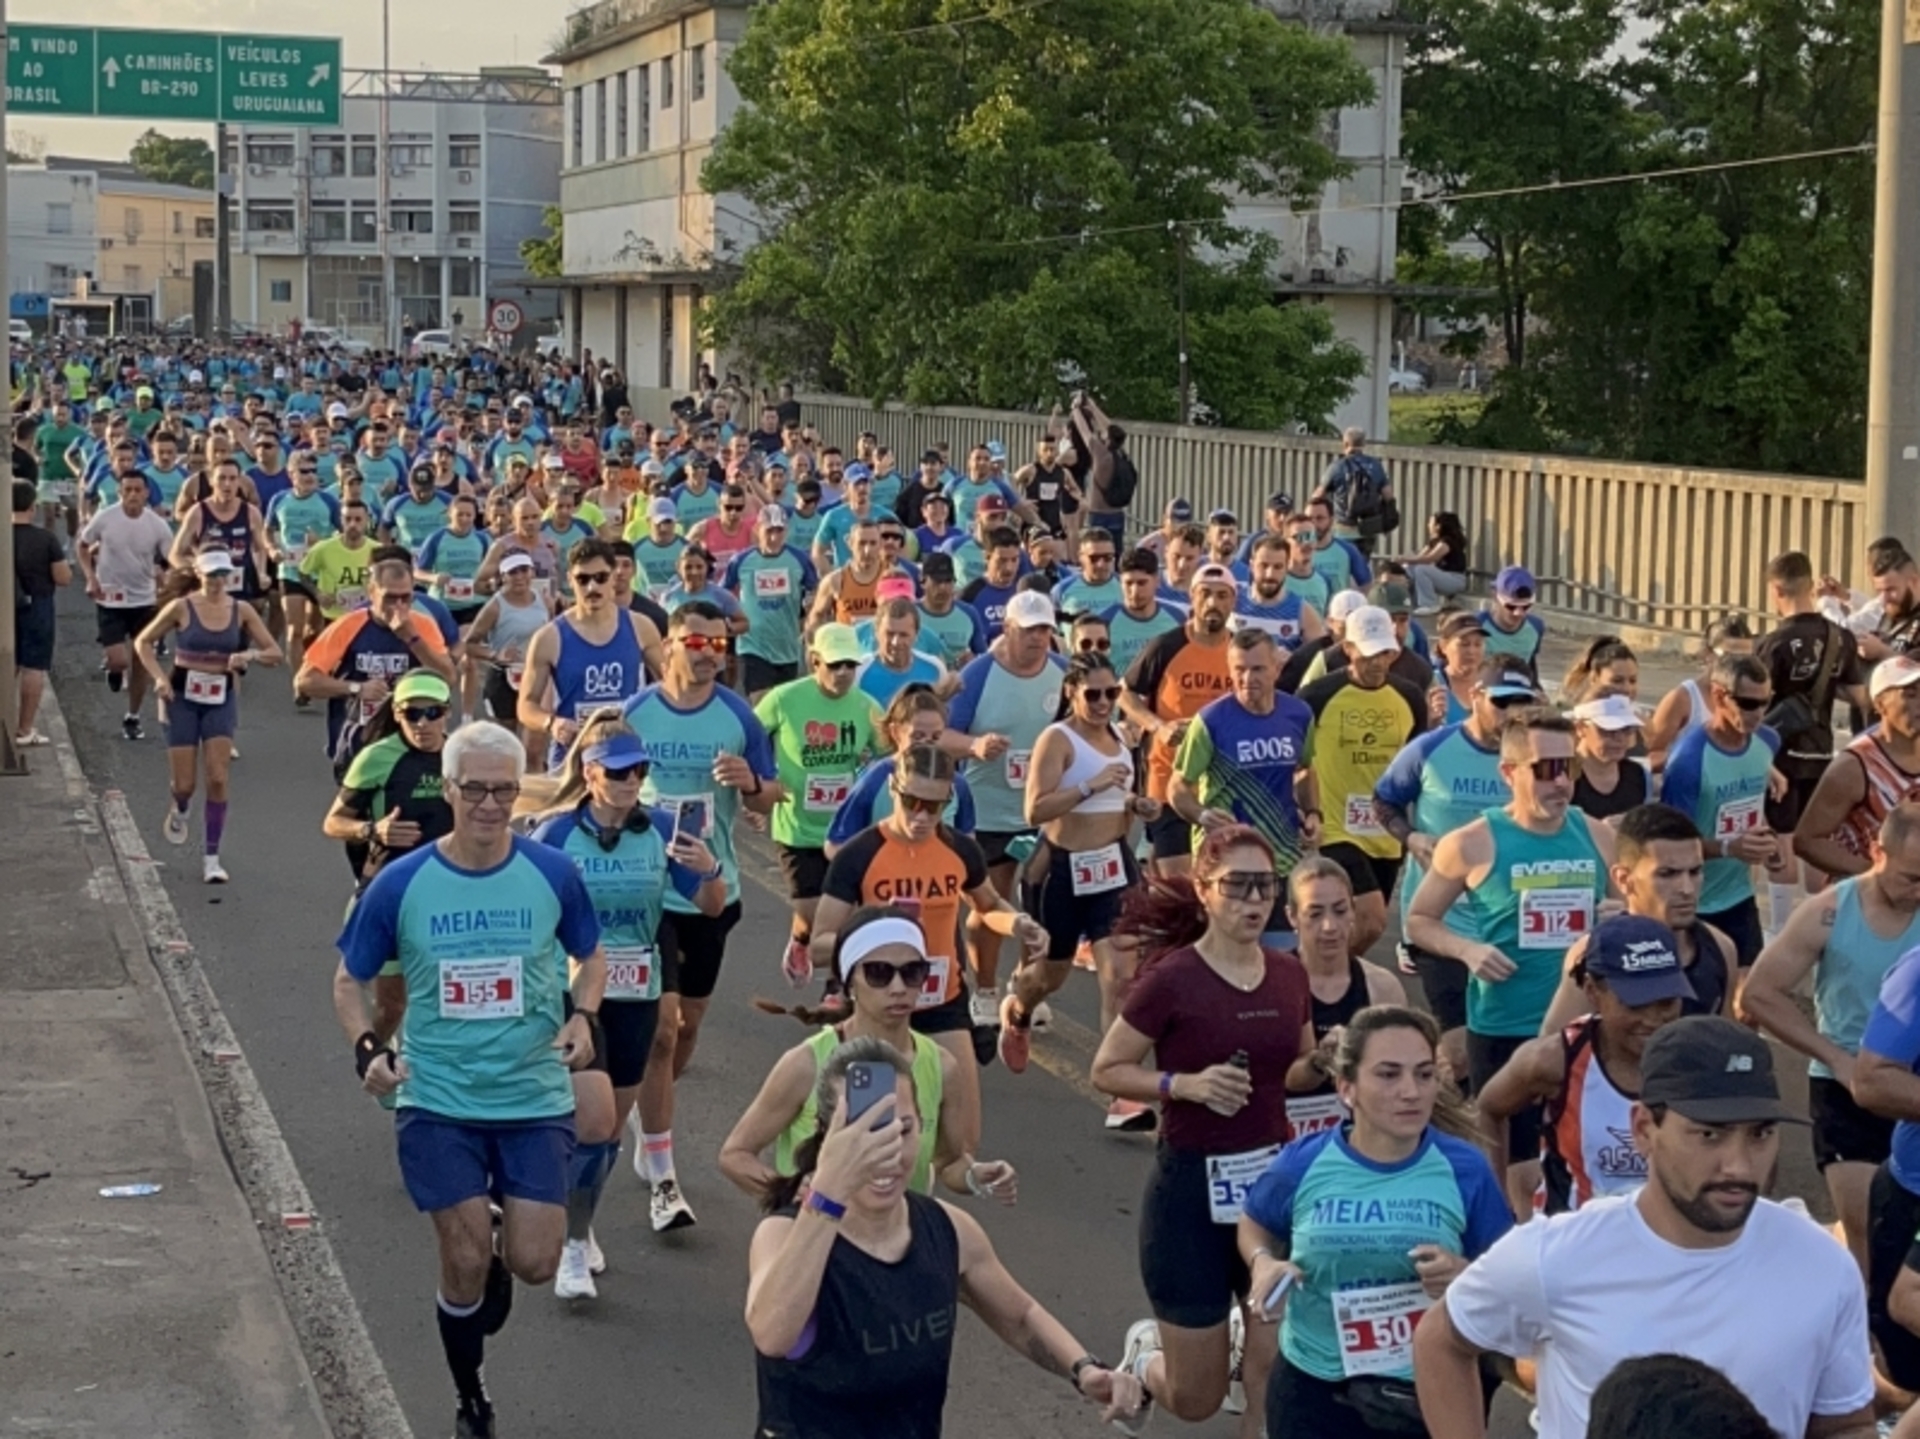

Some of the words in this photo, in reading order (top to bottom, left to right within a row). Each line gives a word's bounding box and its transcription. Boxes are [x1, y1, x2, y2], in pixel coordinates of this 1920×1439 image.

[31, 37, 78, 54] VINDO
[228, 41, 301, 64] VEÍCULOS
[23, 61, 44, 78] AO
[124, 52, 214, 73] CAMINHÕES
[141, 79, 198, 96] BR-290
[239, 71, 288, 88] LEVES
[5, 86, 61, 104] BRASIL
[233, 95, 325, 114] URUGUAIANA
[497, 309, 517, 323] 30
[646, 742, 690, 760] MEIA
[1453, 777, 1499, 796] MEIA
[1511, 860, 1596, 878] EVIDENCE
[431, 909, 489, 937] MEIA
[1543, 911, 1570, 933] 112
[607, 965, 639, 985] 200
[463, 981, 499, 1005] 155
[1312, 1199, 1385, 1225] MEIA
[1386, 1198, 1425, 1209] MARA
[1386, 1210, 1424, 1223] TONA
[1372, 1314, 1411, 1348] 50
